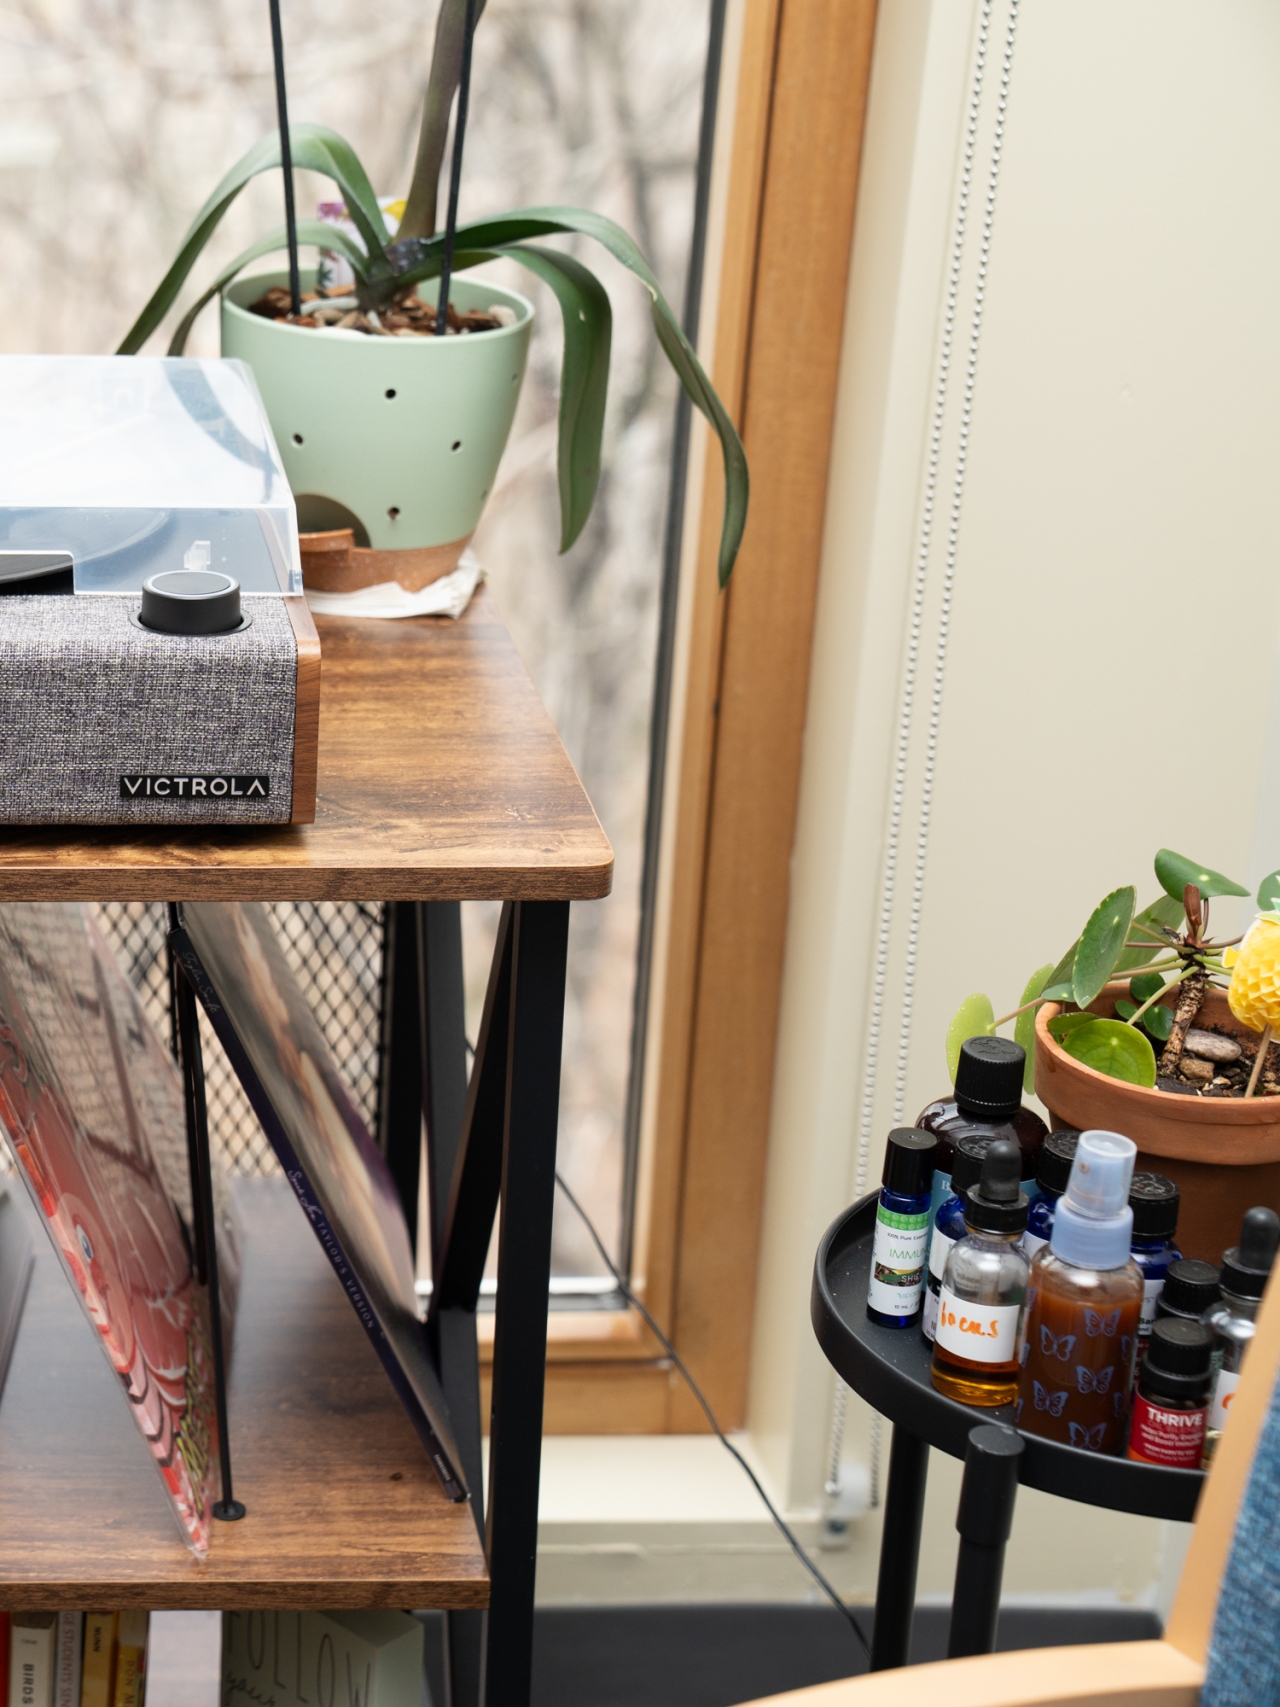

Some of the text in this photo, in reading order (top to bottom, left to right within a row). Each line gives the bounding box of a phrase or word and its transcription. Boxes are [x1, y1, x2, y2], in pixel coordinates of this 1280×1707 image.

[123, 777, 266, 796] VICTROLA
[317, 1221, 348, 1275] TAYLOR'S
[345, 1279, 375, 1329] VERSION
[1146, 1406, 1204, 1428] THRIVE
[93, 1626, 102, 1652] NUNN
[22, 1663, 35, 1705] BIRDS
